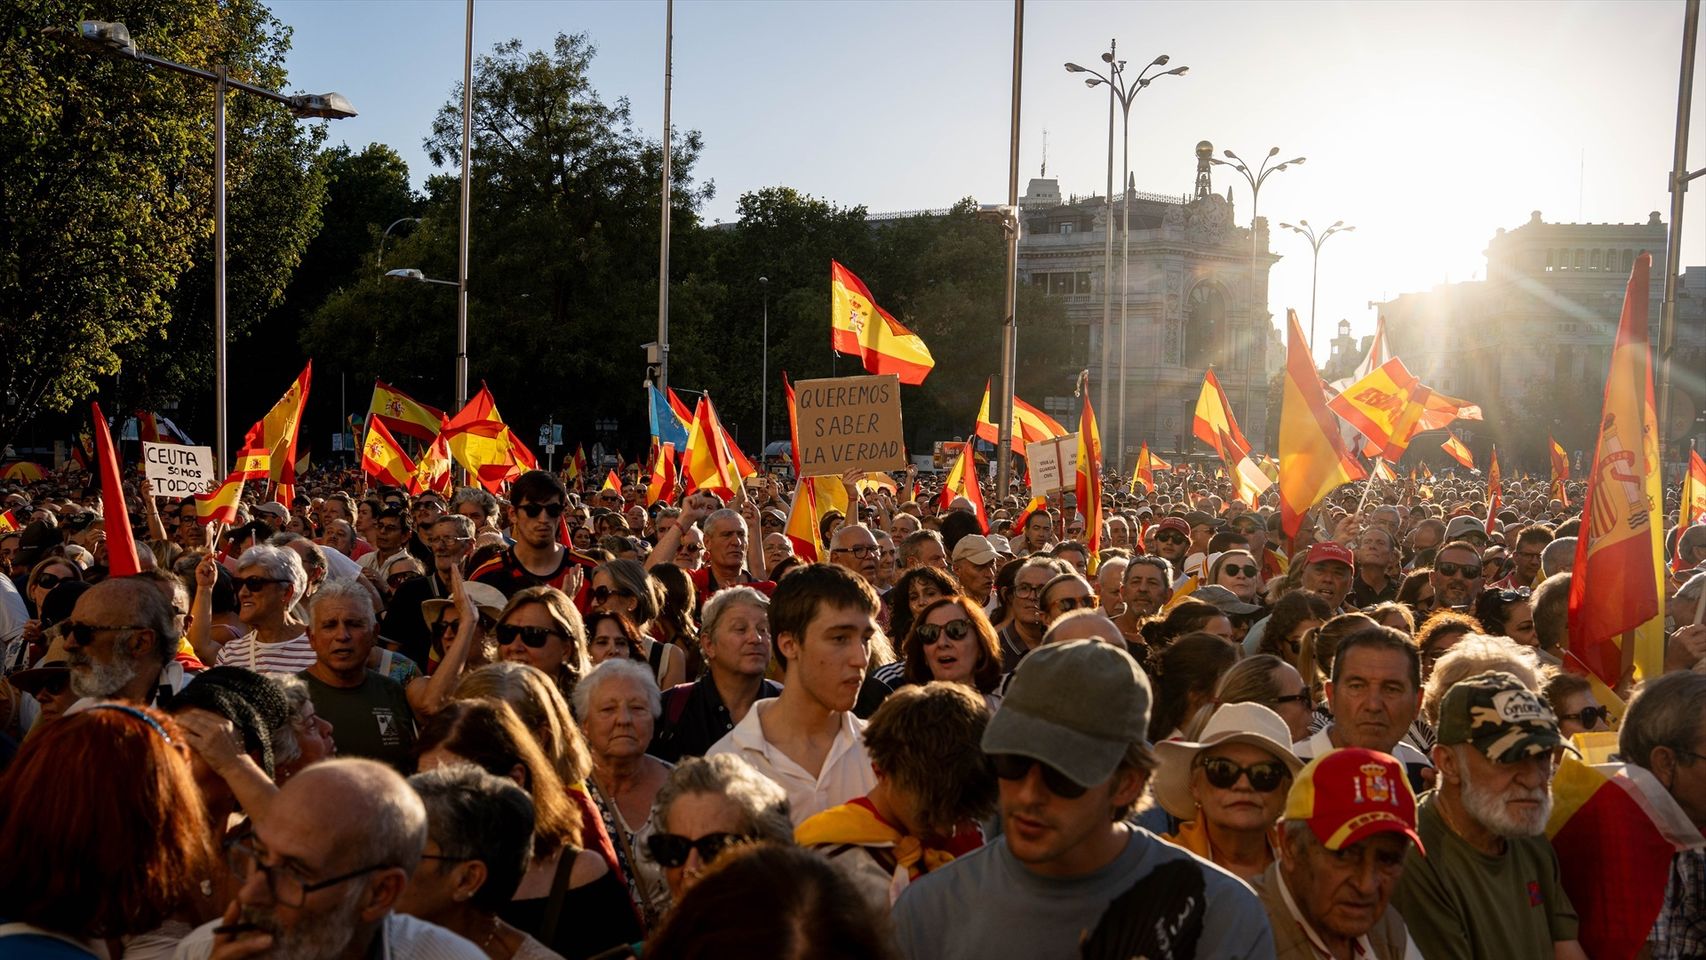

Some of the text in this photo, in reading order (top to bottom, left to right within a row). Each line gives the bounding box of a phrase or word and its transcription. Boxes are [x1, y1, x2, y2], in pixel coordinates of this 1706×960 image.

[800, 383, 889, 409] QUEREMOS
[815, 412, 879, 438] SABER
[803, 440, 899, 464] LA VERDAD
[167, 466, 202, 478] SOMOS
